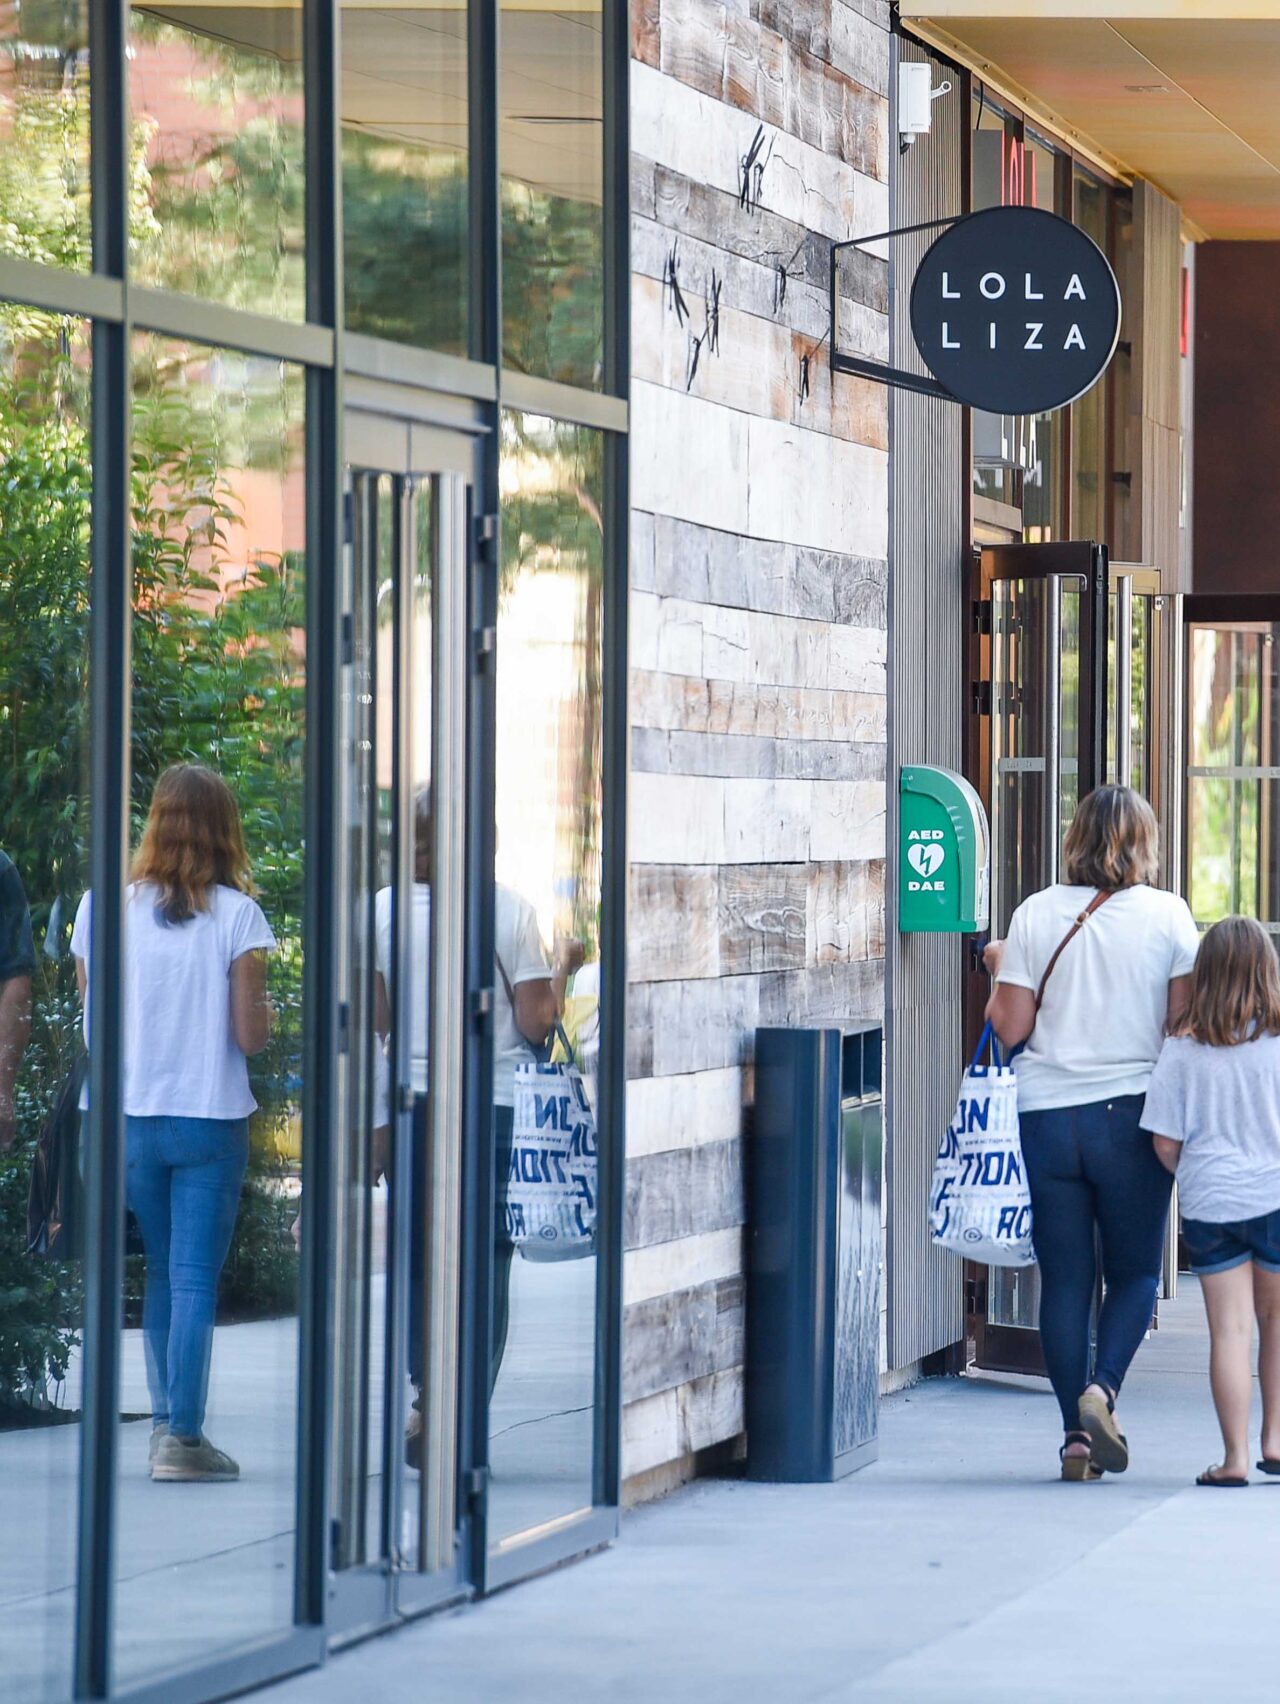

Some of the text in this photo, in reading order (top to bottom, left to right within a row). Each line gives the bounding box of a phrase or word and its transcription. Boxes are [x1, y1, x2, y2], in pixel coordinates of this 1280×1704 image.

[942, 272, 1086, 300] LOLA
[942, 322, 1086, 350] LIZA
[907, 830, 944, 840] AED
[908, 881, 945, 891] DAE
